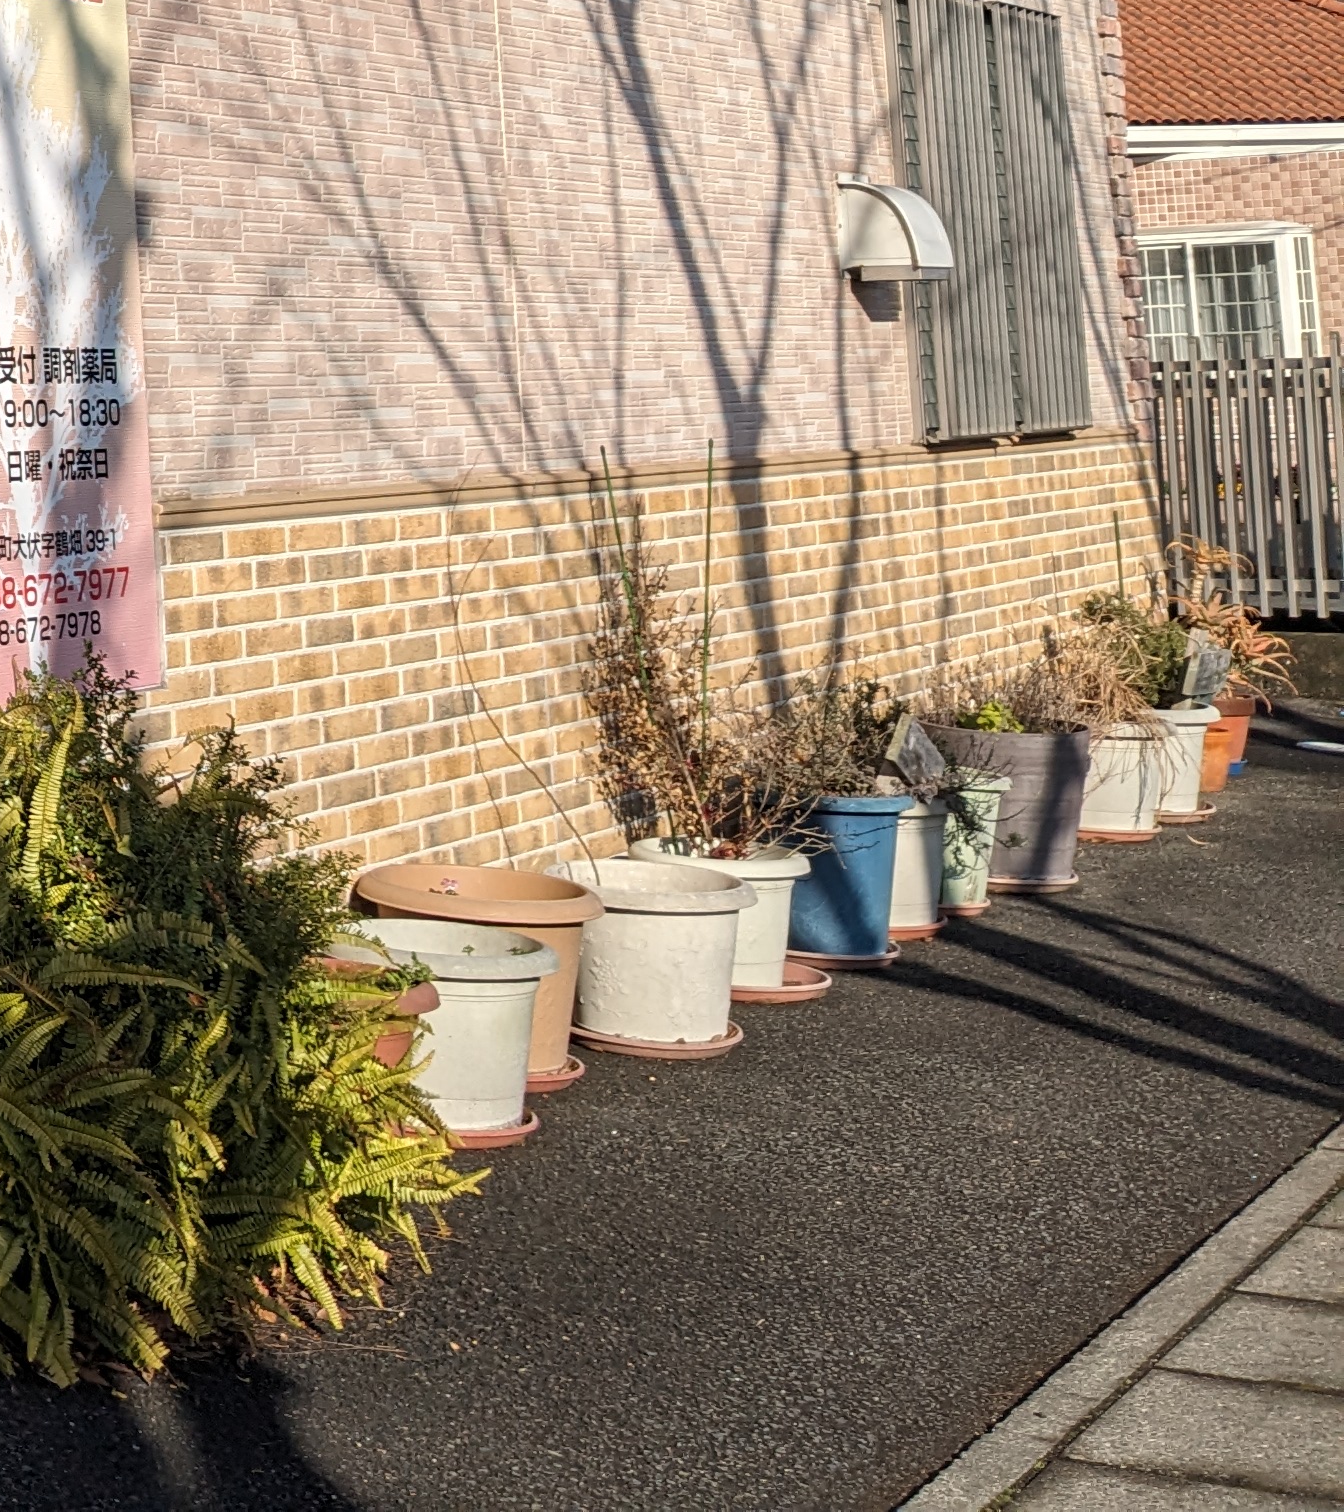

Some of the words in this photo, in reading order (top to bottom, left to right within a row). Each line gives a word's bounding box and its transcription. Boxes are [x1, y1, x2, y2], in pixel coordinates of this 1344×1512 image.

[43, 347, 117, 384] 調剤薬局
[4, 398, 120, 428] 9:00～18:30
[7, 448, 109, 483] 日曜・祝祭日
[86, 528, 117, 553] 39-1
